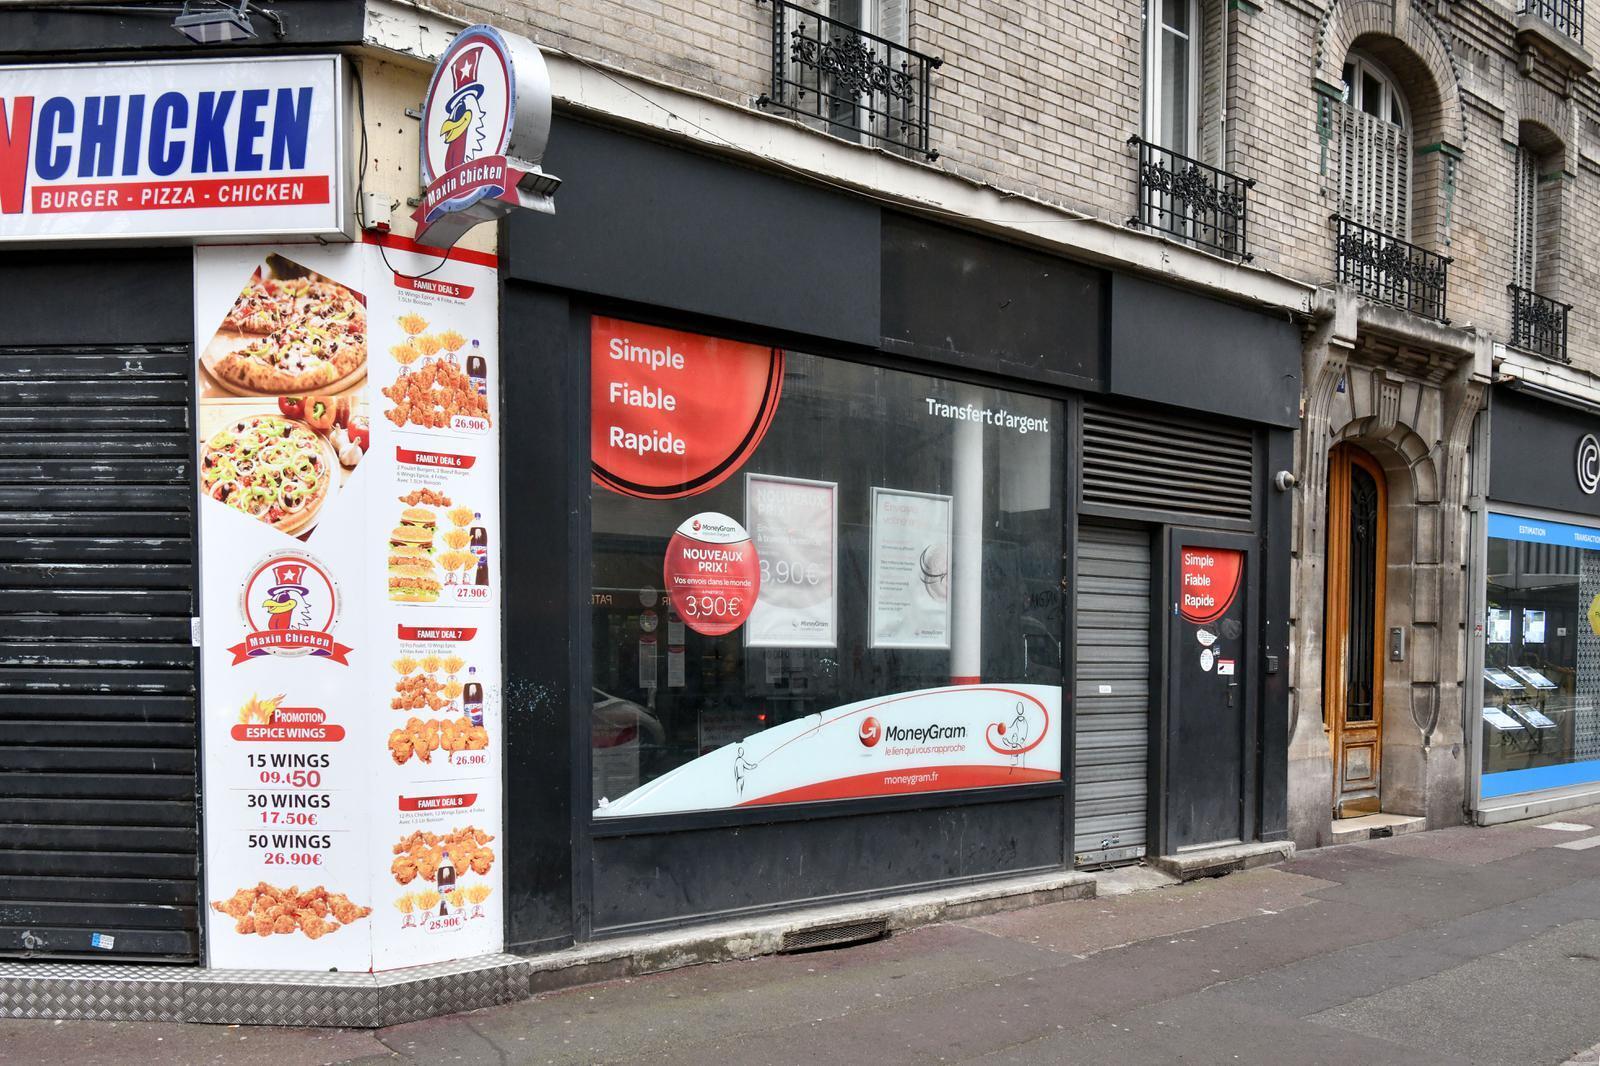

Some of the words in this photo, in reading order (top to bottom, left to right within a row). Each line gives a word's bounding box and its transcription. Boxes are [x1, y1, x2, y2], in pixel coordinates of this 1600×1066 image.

[35, 86, 313, 180] CHICKEN
[428, 174, 457, 207] Maxin
[459, 166, 502, 186] Chicken
[40, 189, 118, 209] BURGER
[141, 188, 195, 206] PIZZA
[218, 183, 303, 202] CHICKEN
[413, 280, 437, 291] FAMILY
[438, 285, 454, 295] DEAL
[609, 338, 685, 371] Simple
[609, 382, 676, 411] Fiable
[926, 398, 993, 425] Transfert
[994, 409, 1049, 434] d'argent
[455, 418, 485, 430] 26.90€
[609, 426, 686, 456] Rapide
[416, 454, 439, 463] FAMILY
[440, 457, 456, 465] DEAL
[456, 458, 462, 466] 6
[702, 524, 736, 533] MoneyGram
[1519, 525, 1546, 536] ESTIMATION
[683, 548, 743, 562] NOUVEAUX
[1185, 553, 1214, 569] Simple
[698, 561, 723, 573] PRIX
[674, 576, 686, 584] Vos
[728, 579, 752, 587] monde
[1185, 573, 1211, 587] Fiable
[457, 588, 488, 598] 27.90€
[685, 596, 741, 619] 3,90€
[1185, 594, 1214, 609] Rapide
[250, 634, 282, 647] Maxin
[285, 633, 330, 647] Chicken
[417, 630, 441, 638] FAMILY
[441, 630, 456, 639] DEAL
[457, 631, 462, 639] 7
[275, 709, 324, 723] PROMOTION
[246, 728, 285, 738] ESPICE
[287, 728, 326, 738] WINGS
[885, 724, 966, 744] MoneyGram
[915, 746, 931, 755] vous
[931, 744, 966, 755] rapproche
[247, 754, 267, 768] 15
[270, 754, 330, 768] WINGS
[456, 754, 486, 766] 26.90€
[884, 771, 939, 785] moneygram.fr
[247, 794, 267, 808] 30
[272, 794, 331, 808] WINGS
[418, 799, 441, 808] FAMILY
[442, 798, 458, 807] DEAL
[458, 797, 463, 805] 8
[260, 811, 318, 825] 17.50€
[248, 835, 269, 849] 50
[272, 835, 331, 849] WINGS
[264, 852, 323, 866] 26.90€
[429, 917, 461, 930] 28.90€
